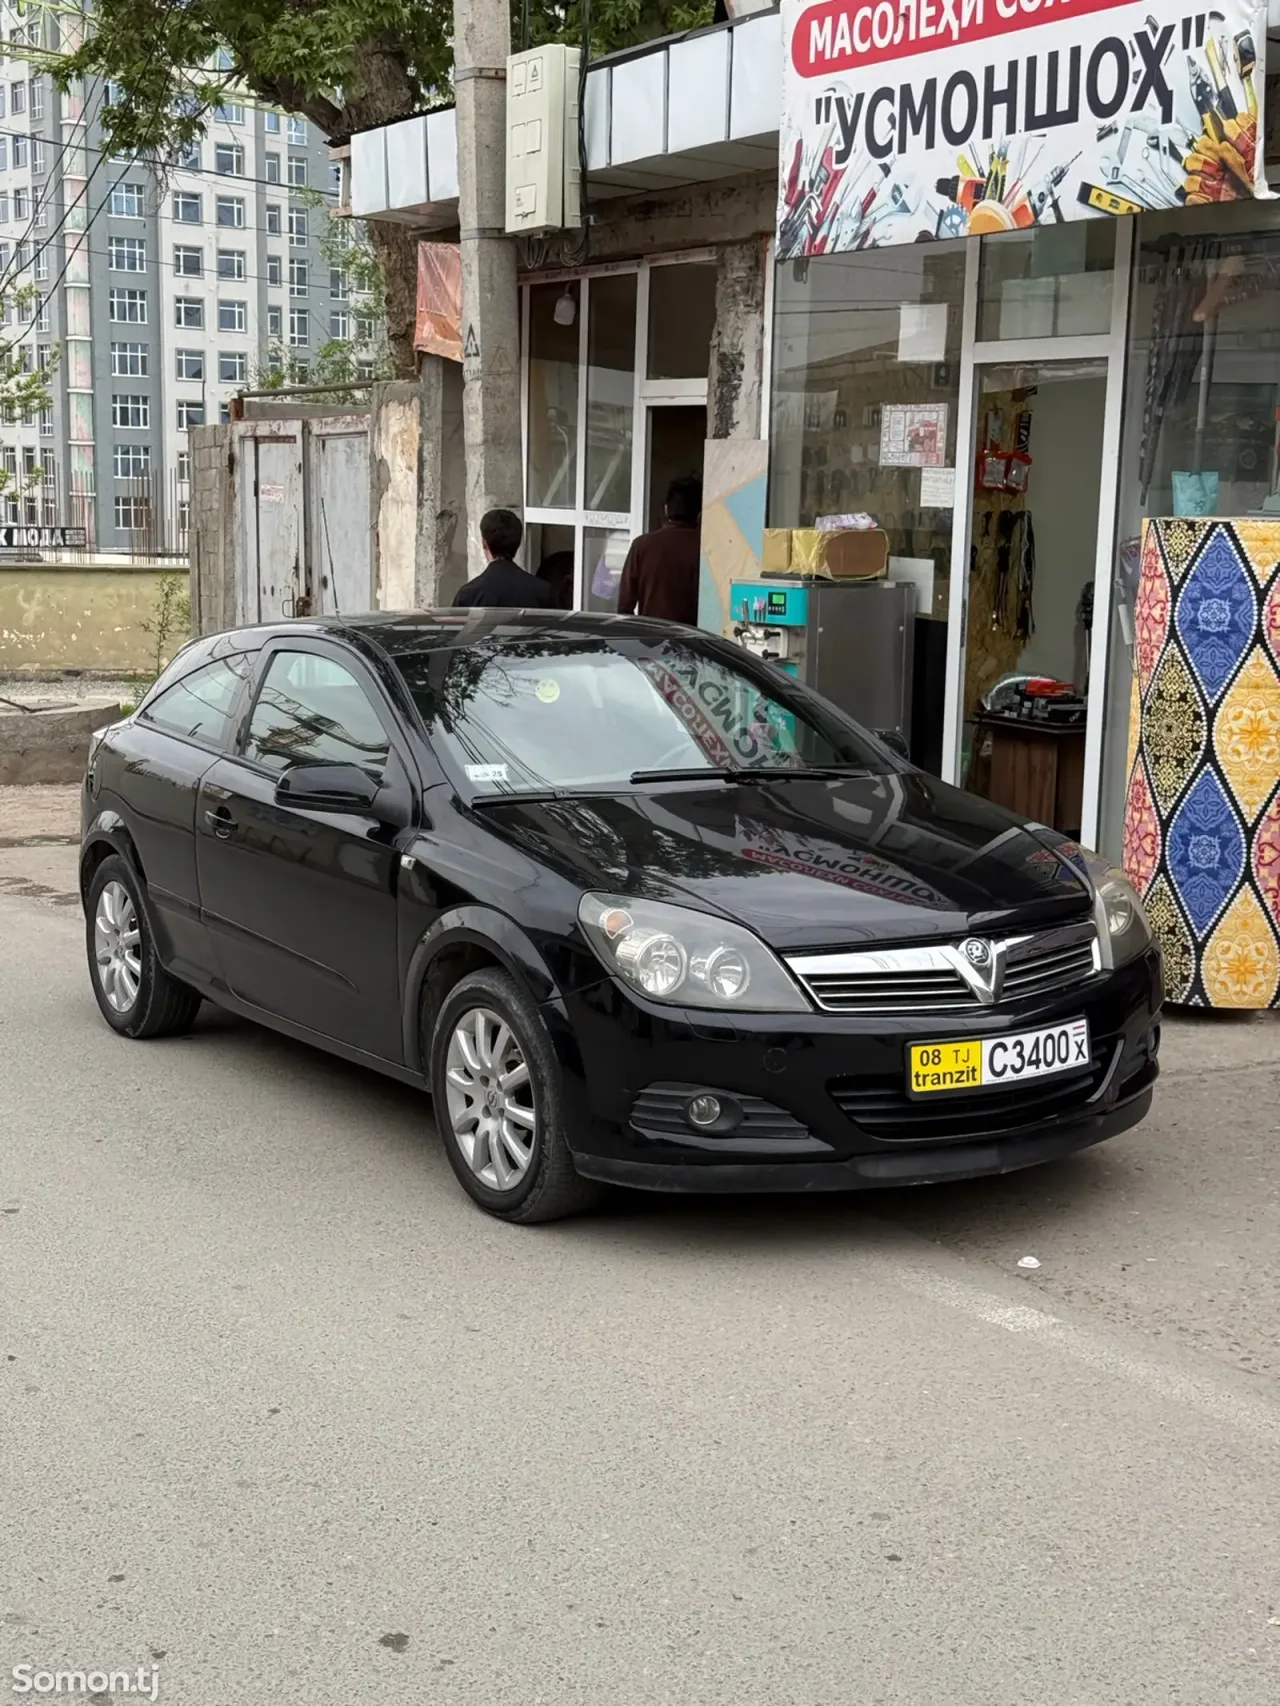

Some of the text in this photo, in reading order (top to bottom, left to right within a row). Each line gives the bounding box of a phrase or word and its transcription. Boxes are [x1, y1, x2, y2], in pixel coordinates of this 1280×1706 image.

[919, 1048, 970, 1067] 08 TJ
[988, 1029, 1069, 1078] C3400
[1074, 1038, 1087, 1061] X
[914, 1066, 977, 1087] tranzit
